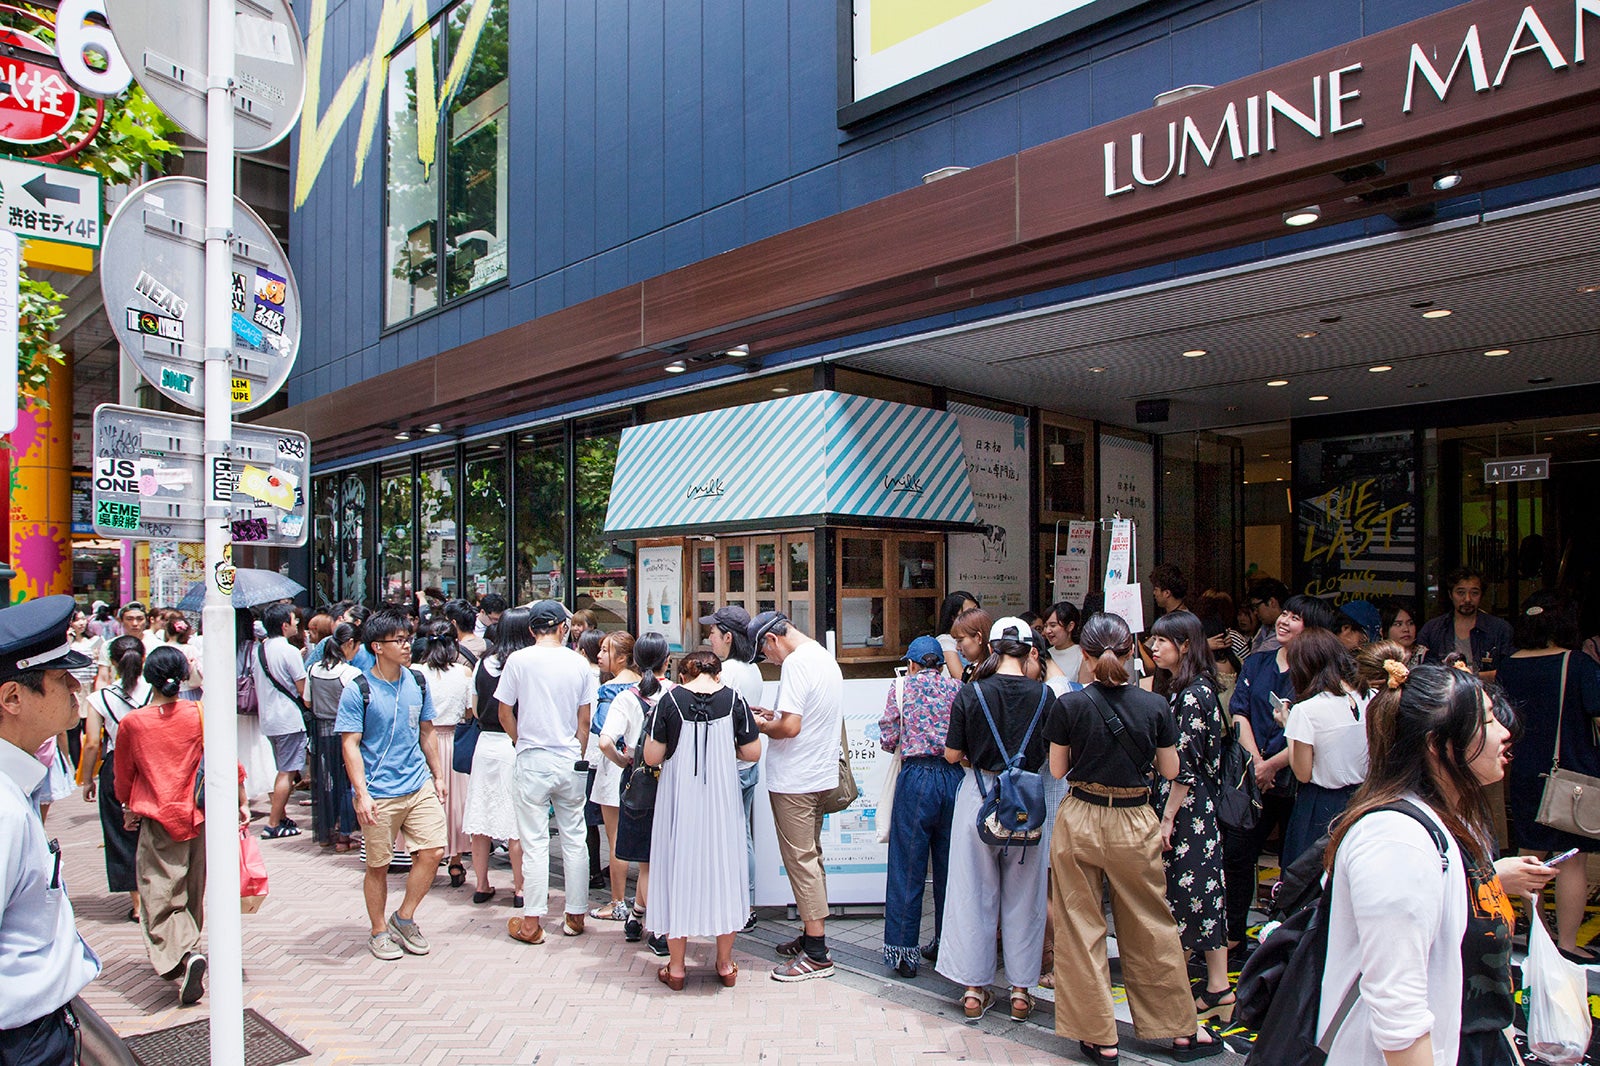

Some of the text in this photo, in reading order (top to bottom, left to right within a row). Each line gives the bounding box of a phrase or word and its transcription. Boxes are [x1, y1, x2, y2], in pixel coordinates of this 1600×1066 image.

[1103, 62, 1364, 198] LUMINE
[256, 304, 284, 324] 24K
[231, 391, 249, 401] UPE
[101, 459, 135, 478] JS
[965, 462, 1020, 481] クリーム専門店」
[1511, 465, 1527, 476] 2F
[96, 478, 140, 493] ONE
[687, 478, 724, 498] milk
[884, 474, 922, 491] milk
[98, 500, 139, 517] XEME
[1315, 478, 1380, 523] THE
[1304, 501, 1411, 566] LAST
[1304, 568, 1376, 597] CLOSING
[849, 749, 876, 760] OPEN
